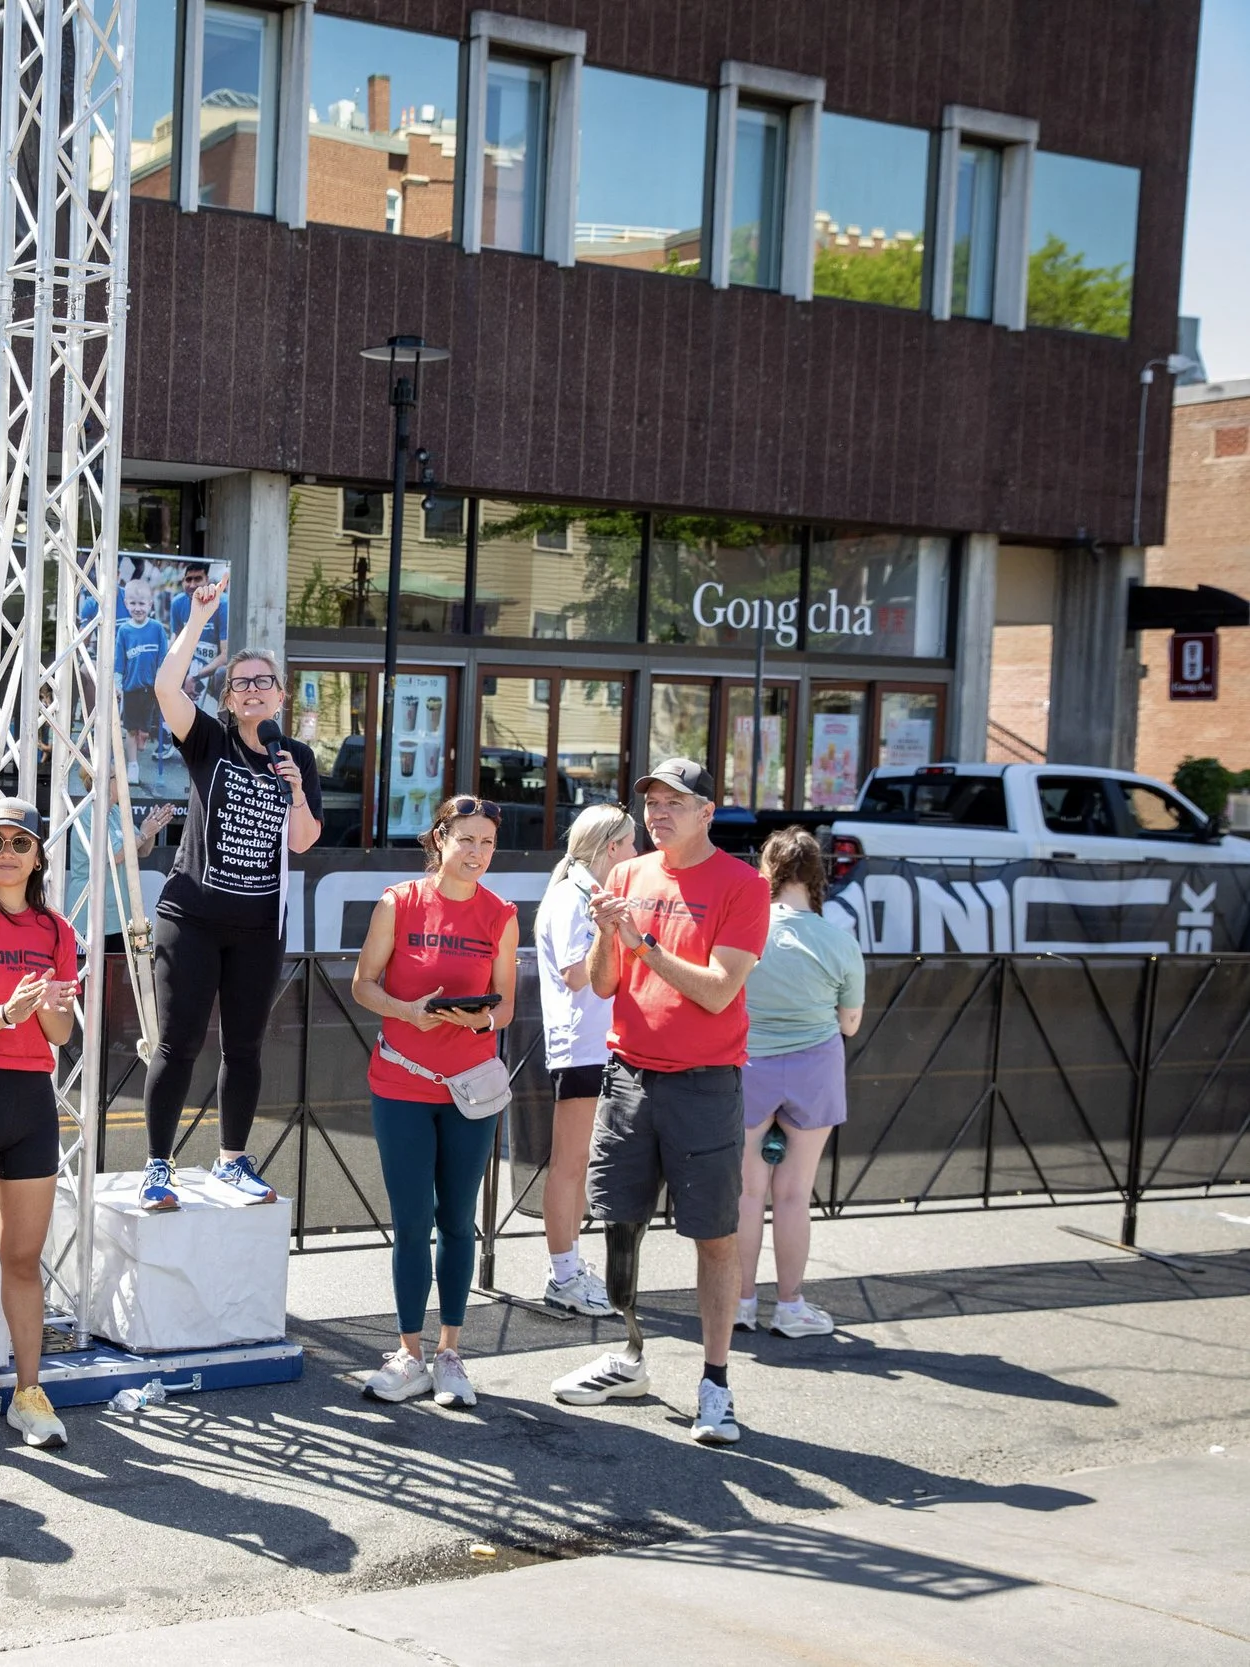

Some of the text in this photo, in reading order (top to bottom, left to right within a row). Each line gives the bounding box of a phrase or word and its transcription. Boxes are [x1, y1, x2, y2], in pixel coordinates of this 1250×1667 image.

[692, 581, 874, 648] Gong cha
[224, 781, 254, 794] come
[257, 790, 277, 801] for
[251, 780, 276, 790] time
[227, 790, 286, 814] to civilize
[217, 808, 232, 821] by
[234, 814, 255, 827] the
[226, 803, 283, 823] ourselves
[220, 822, 258, 838] direct
[216, 841, 267, 858] abolition
[220, 869, 241, 880] Martin
[408, 933, 493, 955] BIONIC
